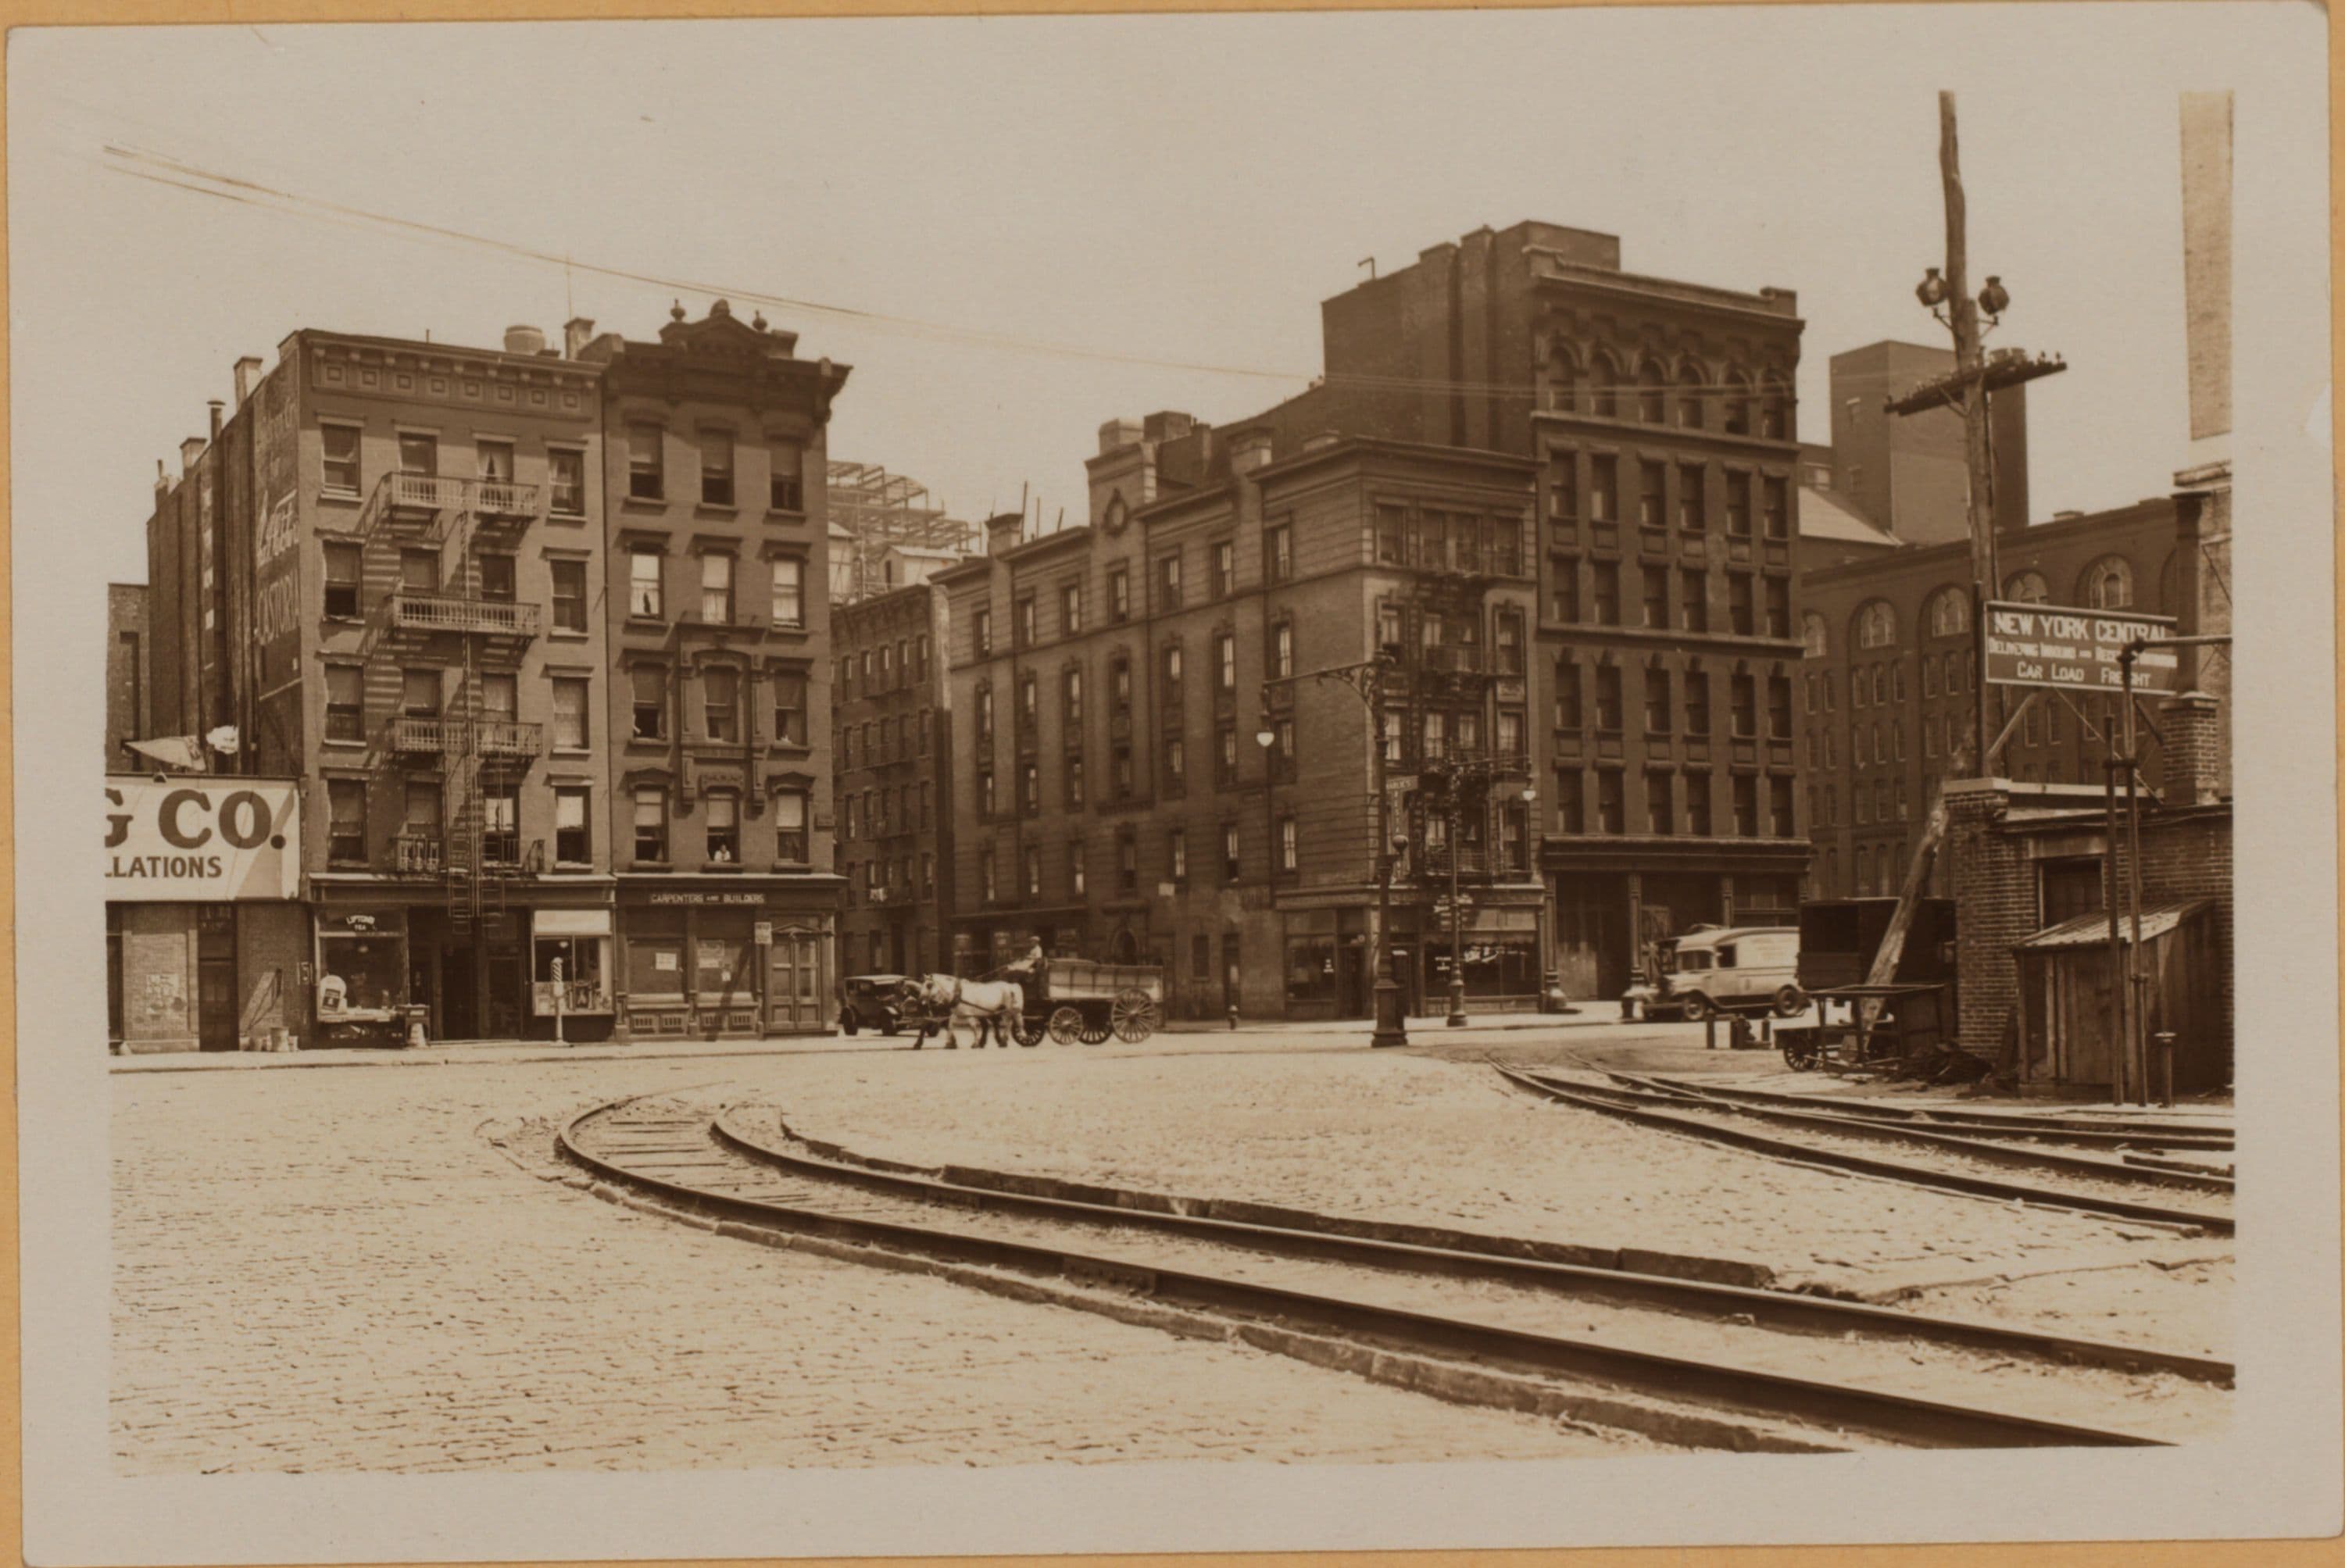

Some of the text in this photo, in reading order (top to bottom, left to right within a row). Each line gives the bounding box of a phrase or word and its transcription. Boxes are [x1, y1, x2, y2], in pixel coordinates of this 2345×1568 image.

[1994, 611, 2165, 643] NEW YORK CENTRAL
[2017, 661, 2151, 688] CAR LOAD FREGHT
[158, 788, 287, 850] CO.
[650, 893, 703, 905] CARPENTERS
[724, 893, 765, 905] BUILDERS
